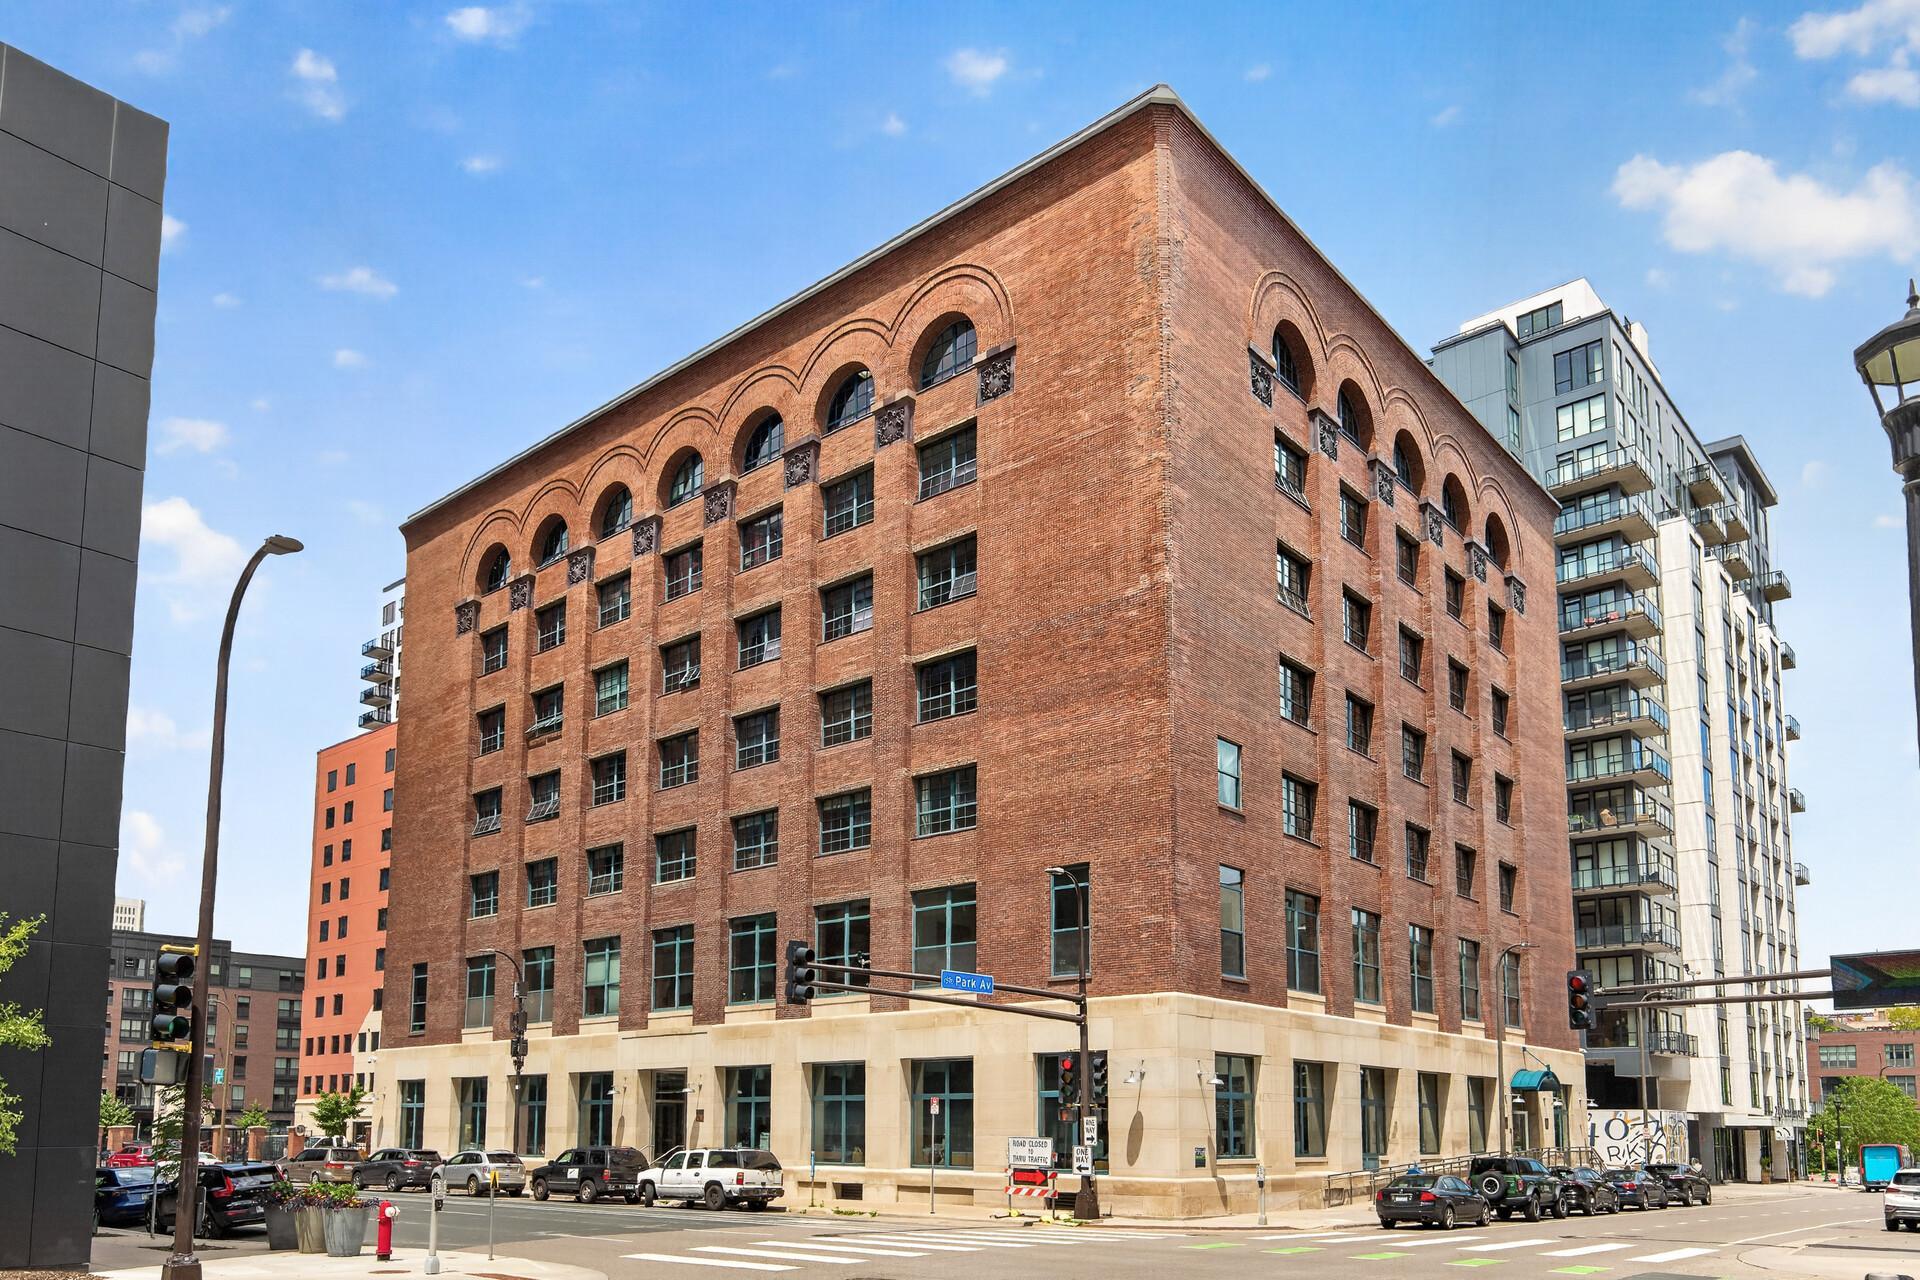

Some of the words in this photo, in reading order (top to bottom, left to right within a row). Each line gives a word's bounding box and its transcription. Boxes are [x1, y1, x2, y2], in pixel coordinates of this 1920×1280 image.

[955, 976, 977, 988] Park
[980, 980, 991, 990] Av
[1028, 1140, 1048, 1148] CLOSED
[1028, 1155, 1048, 1164] TRAFFIC
